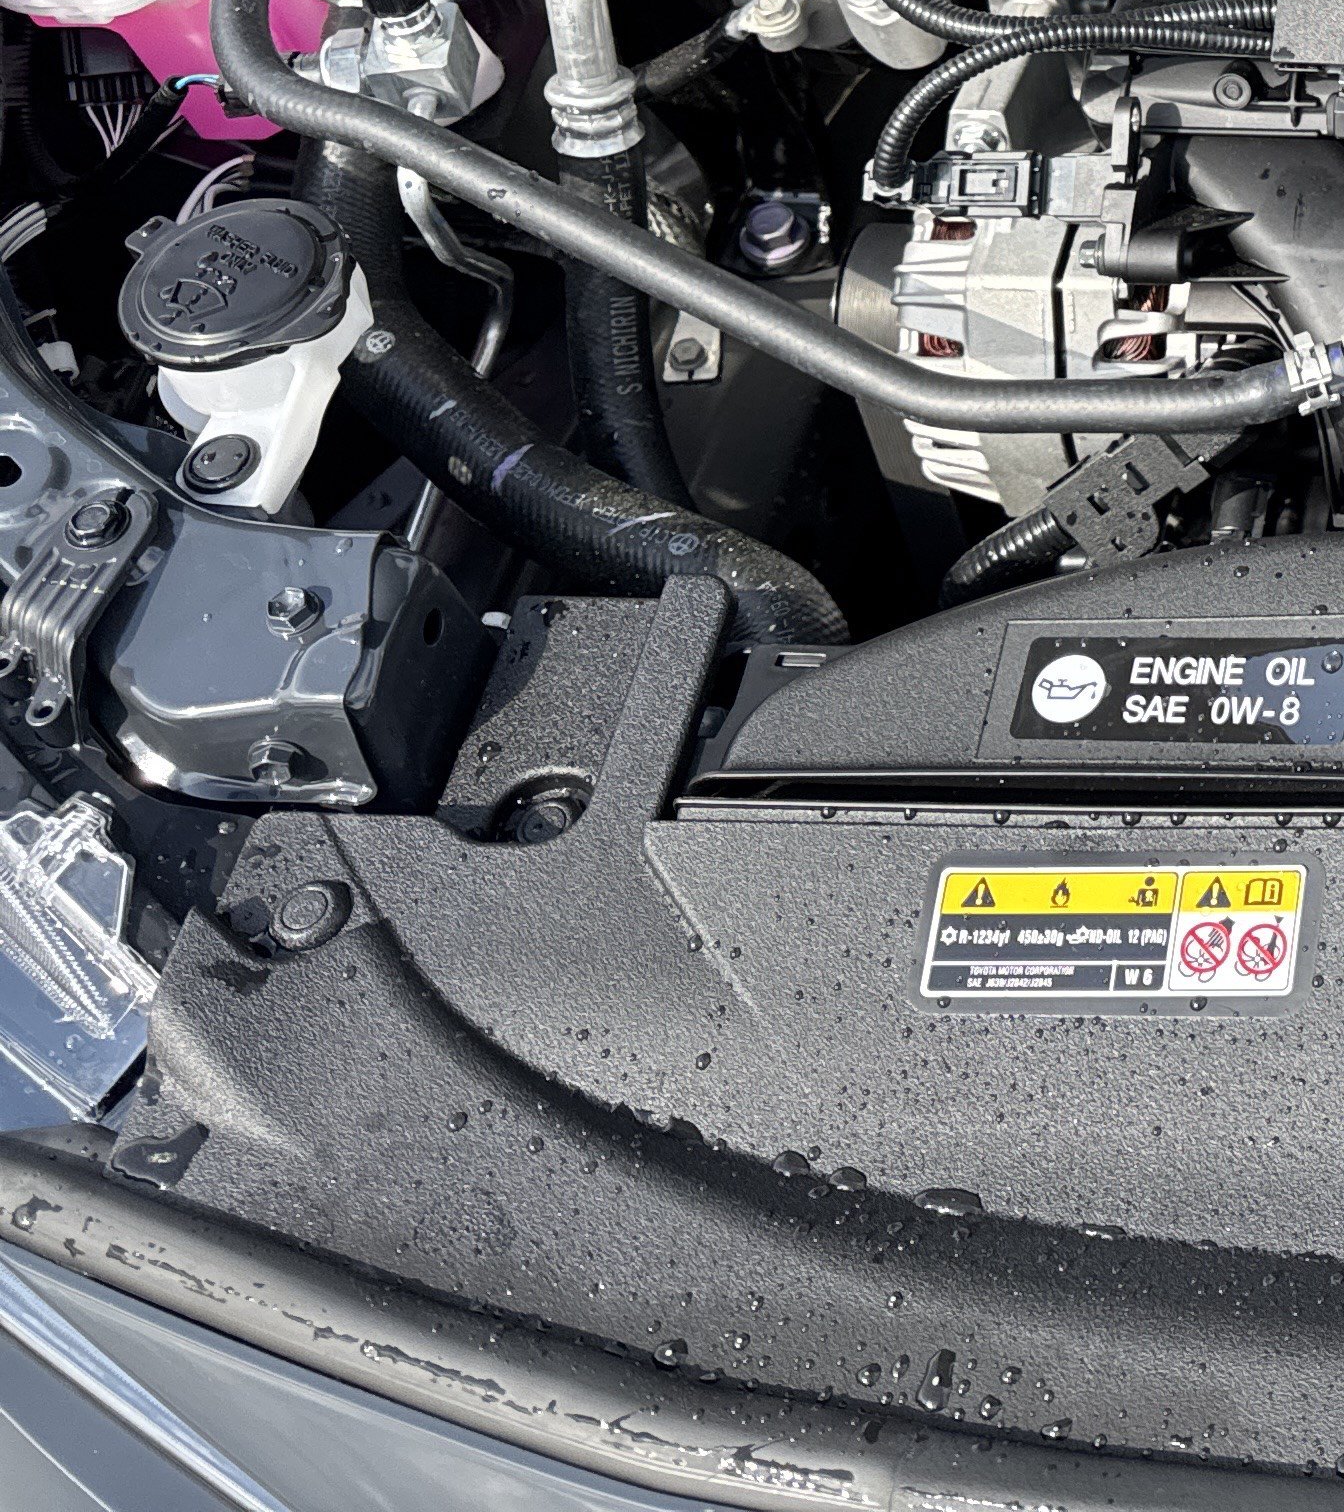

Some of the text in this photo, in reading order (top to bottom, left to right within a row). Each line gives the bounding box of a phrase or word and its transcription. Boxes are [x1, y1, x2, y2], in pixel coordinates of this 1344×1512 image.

[1129, 656, 1315, 686] ENGINE OIL
[1122, 694, 1300, 726] SAE 0W-8
[1128, 928, 1141, 944] 12
[1141, 928, 1168, 946] (PAG)
[970, 966, 1075, 976] TOYOTA MOTOR CORPORATION
[1124, 969, 1154, 986] W 6
[967, 978, 982, 988] SAE
